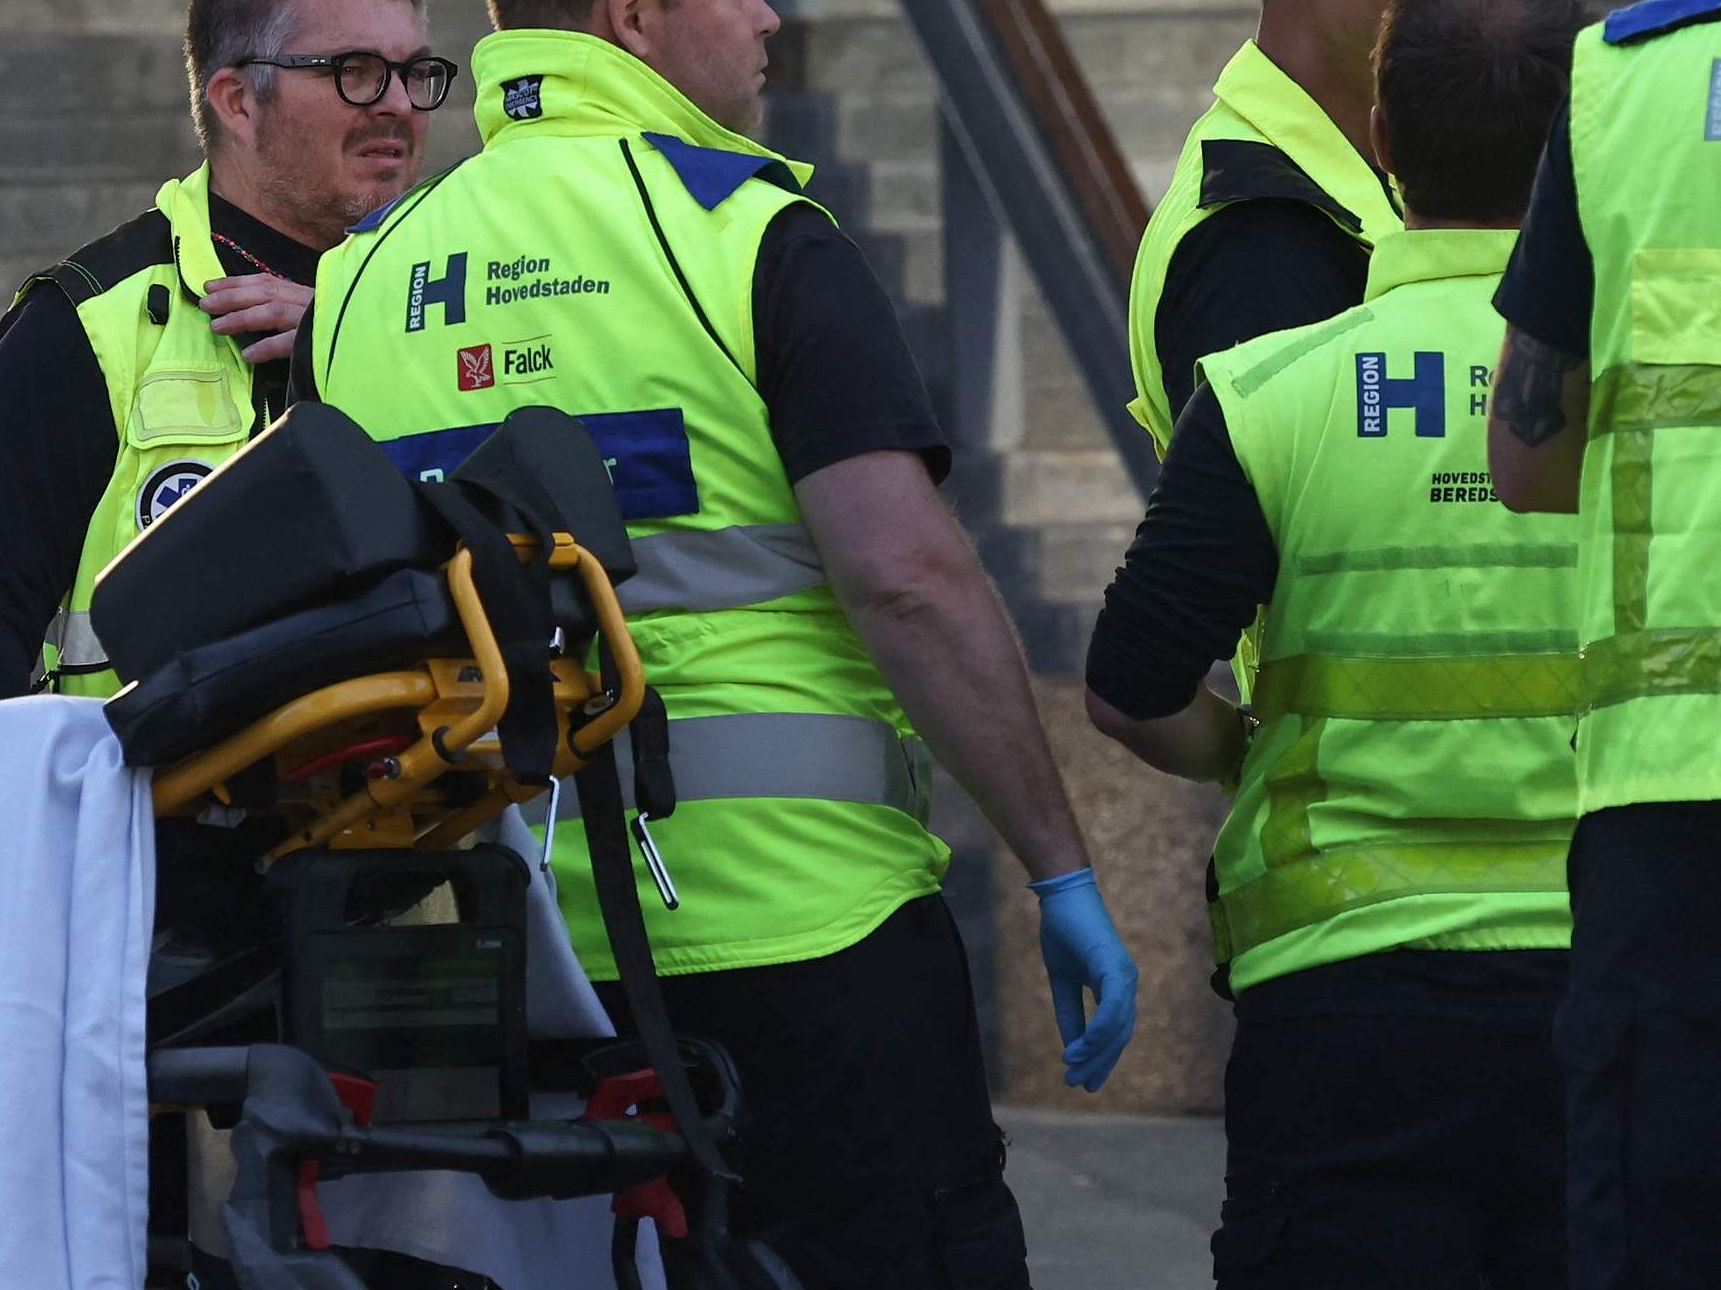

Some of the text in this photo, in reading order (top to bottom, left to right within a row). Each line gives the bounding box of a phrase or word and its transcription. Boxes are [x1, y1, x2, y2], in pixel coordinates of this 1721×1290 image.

[487, 255, 550, 282] Region
[409, 265, 427, 329] REGION
[485, 275, 610, 306] Hovedstaden
[503, 344, 554, 375] Falck
[1362, 356, 1380, 432] REGION
